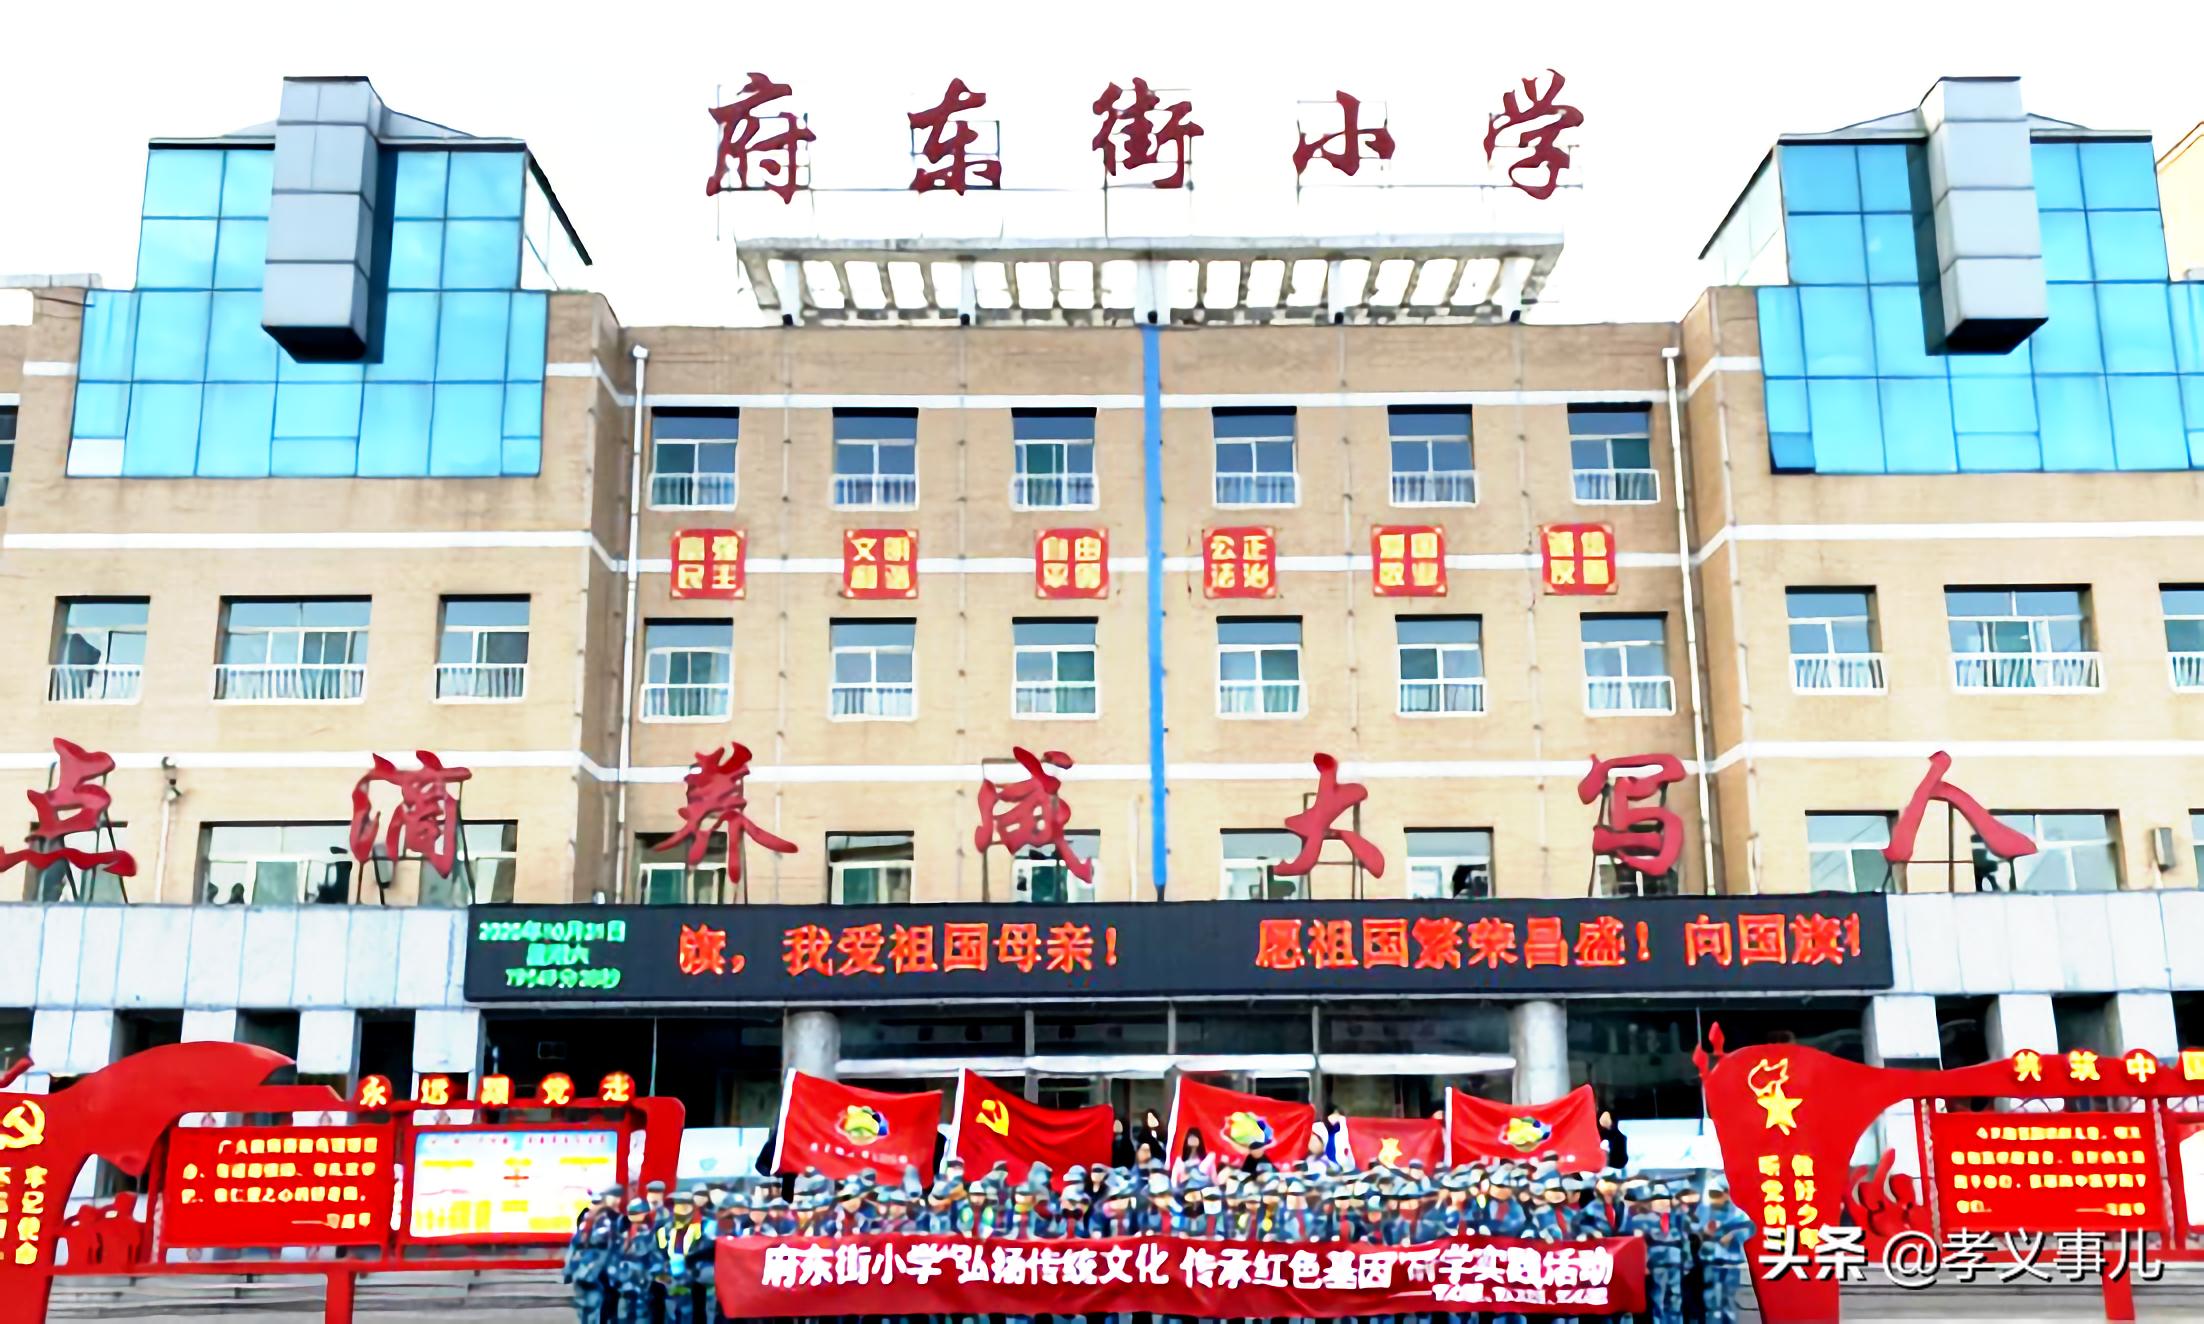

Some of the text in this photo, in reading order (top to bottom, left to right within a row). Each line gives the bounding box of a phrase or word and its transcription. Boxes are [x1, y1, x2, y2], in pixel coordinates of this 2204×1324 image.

[706, 73, 1584, 203] 府东街小学
[1210, 535, 1267, 560] 公正
[678, 564, 736, 589] 民主
[1211, 563, 1268, 588] 法治
[0, 737, 2036, 885] 点滴养成大写人
